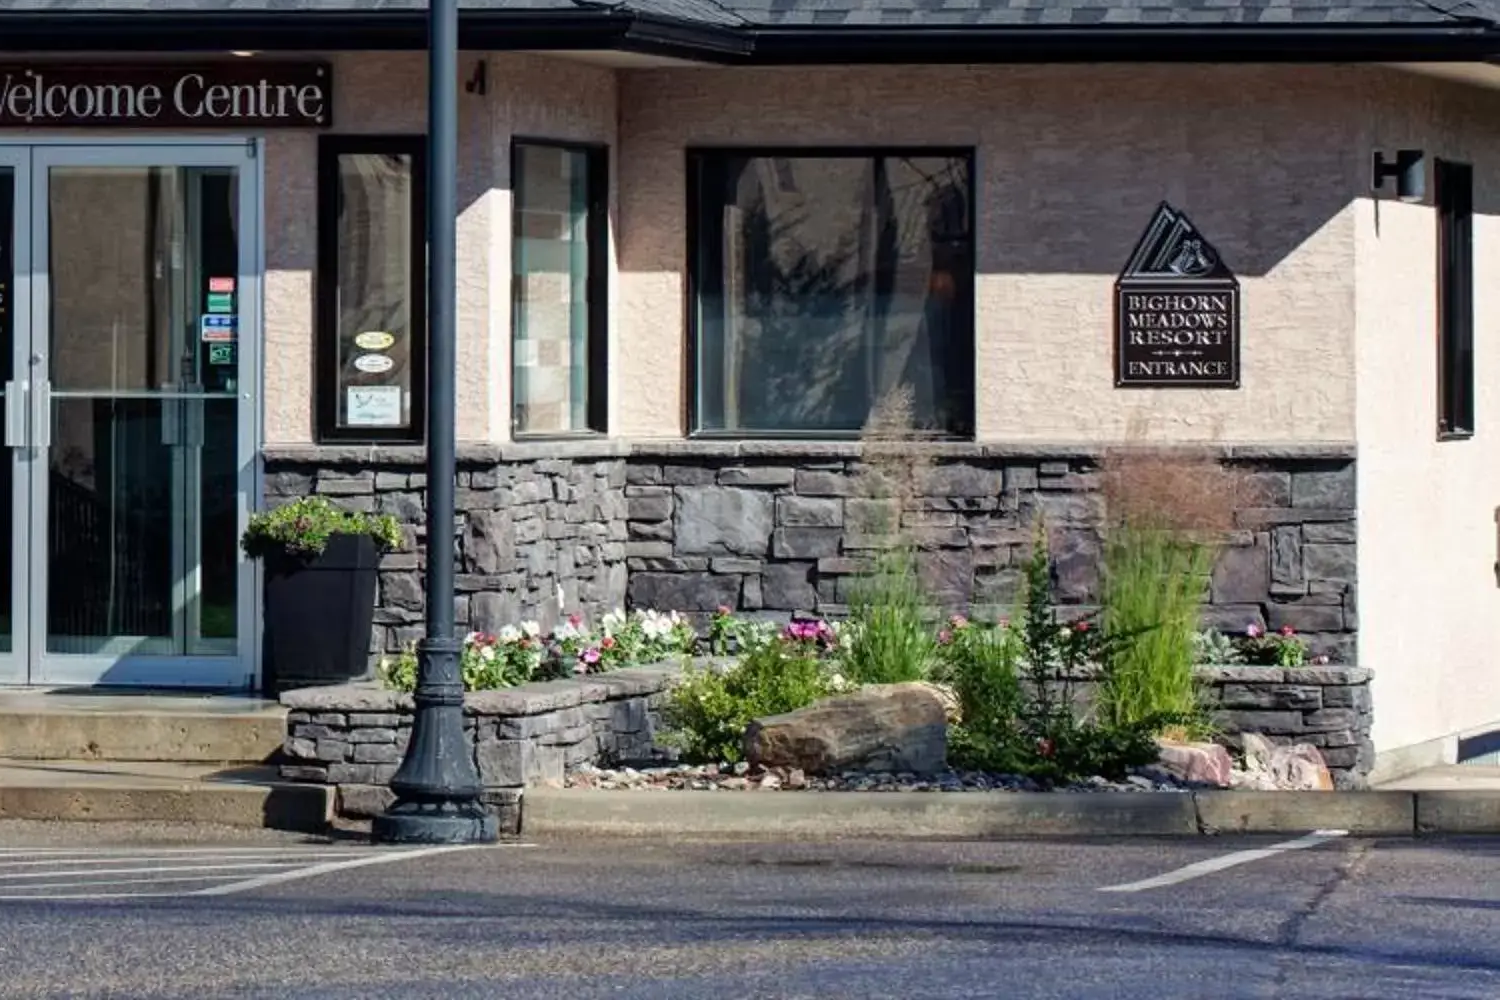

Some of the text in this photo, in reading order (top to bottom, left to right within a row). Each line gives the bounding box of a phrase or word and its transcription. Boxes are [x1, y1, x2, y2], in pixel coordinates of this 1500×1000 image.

[173, 73, 324, 118] Centre
[1128, 296, 1227, 311] BIGHORN
[1128, 313, 1228, 328] MEADOWS
[1129, 330, 1227, 345] RESORT
[1128, 362, 1228, 375] ENTRANCE
